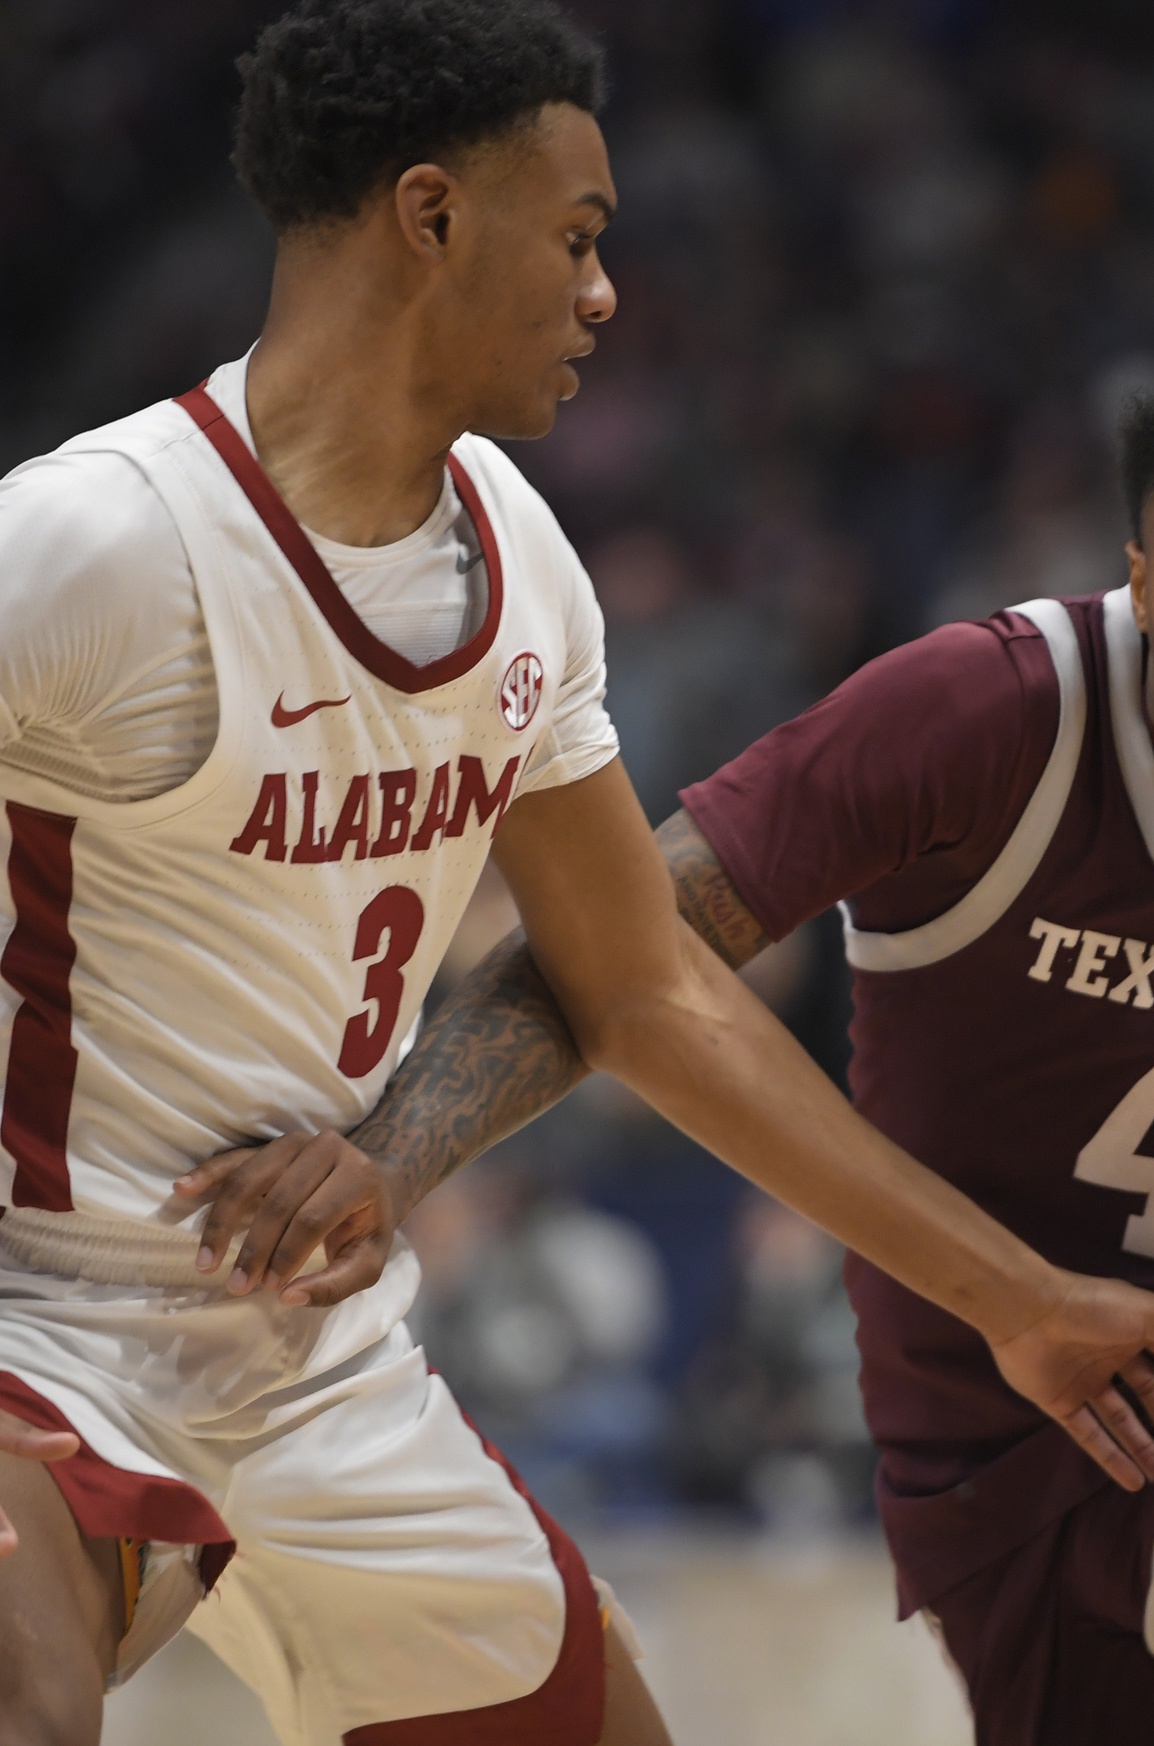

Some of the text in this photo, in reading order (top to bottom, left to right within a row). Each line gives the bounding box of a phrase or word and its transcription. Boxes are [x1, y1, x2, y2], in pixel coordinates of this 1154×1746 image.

[501, 657, 541, 728] SEC
[229, 742, 536, 864] ALABAM
[337, 885, 424, 1078] 3
